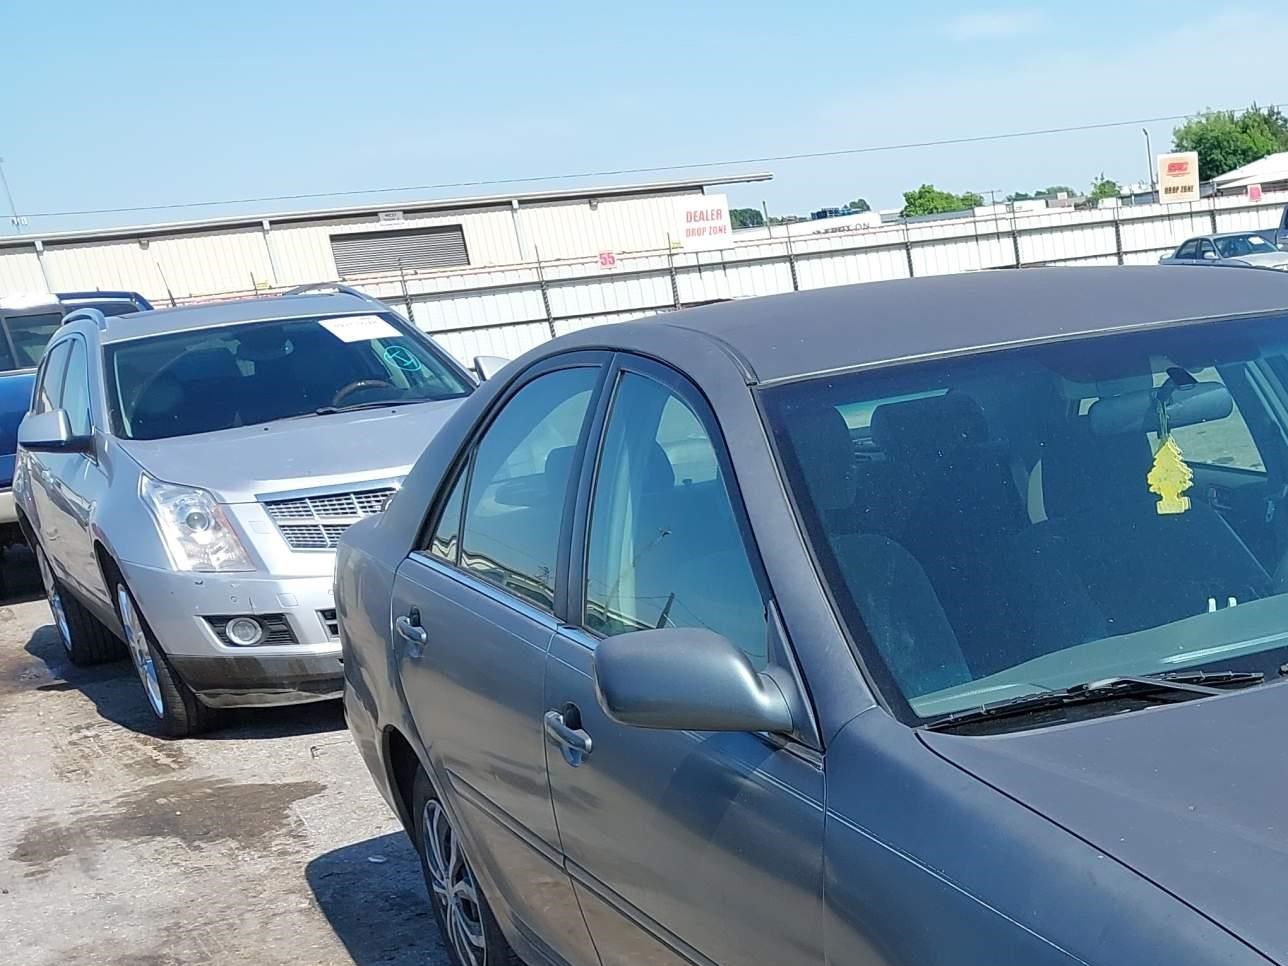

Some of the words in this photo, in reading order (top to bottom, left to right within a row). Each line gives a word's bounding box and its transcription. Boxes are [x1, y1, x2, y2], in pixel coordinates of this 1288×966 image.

[685, 208, 723, 223] DEALER
[685, 227, 706, 238] DROP
[708, 224, 727, 236] ZONE
[599, 252, 616, 266] 55
